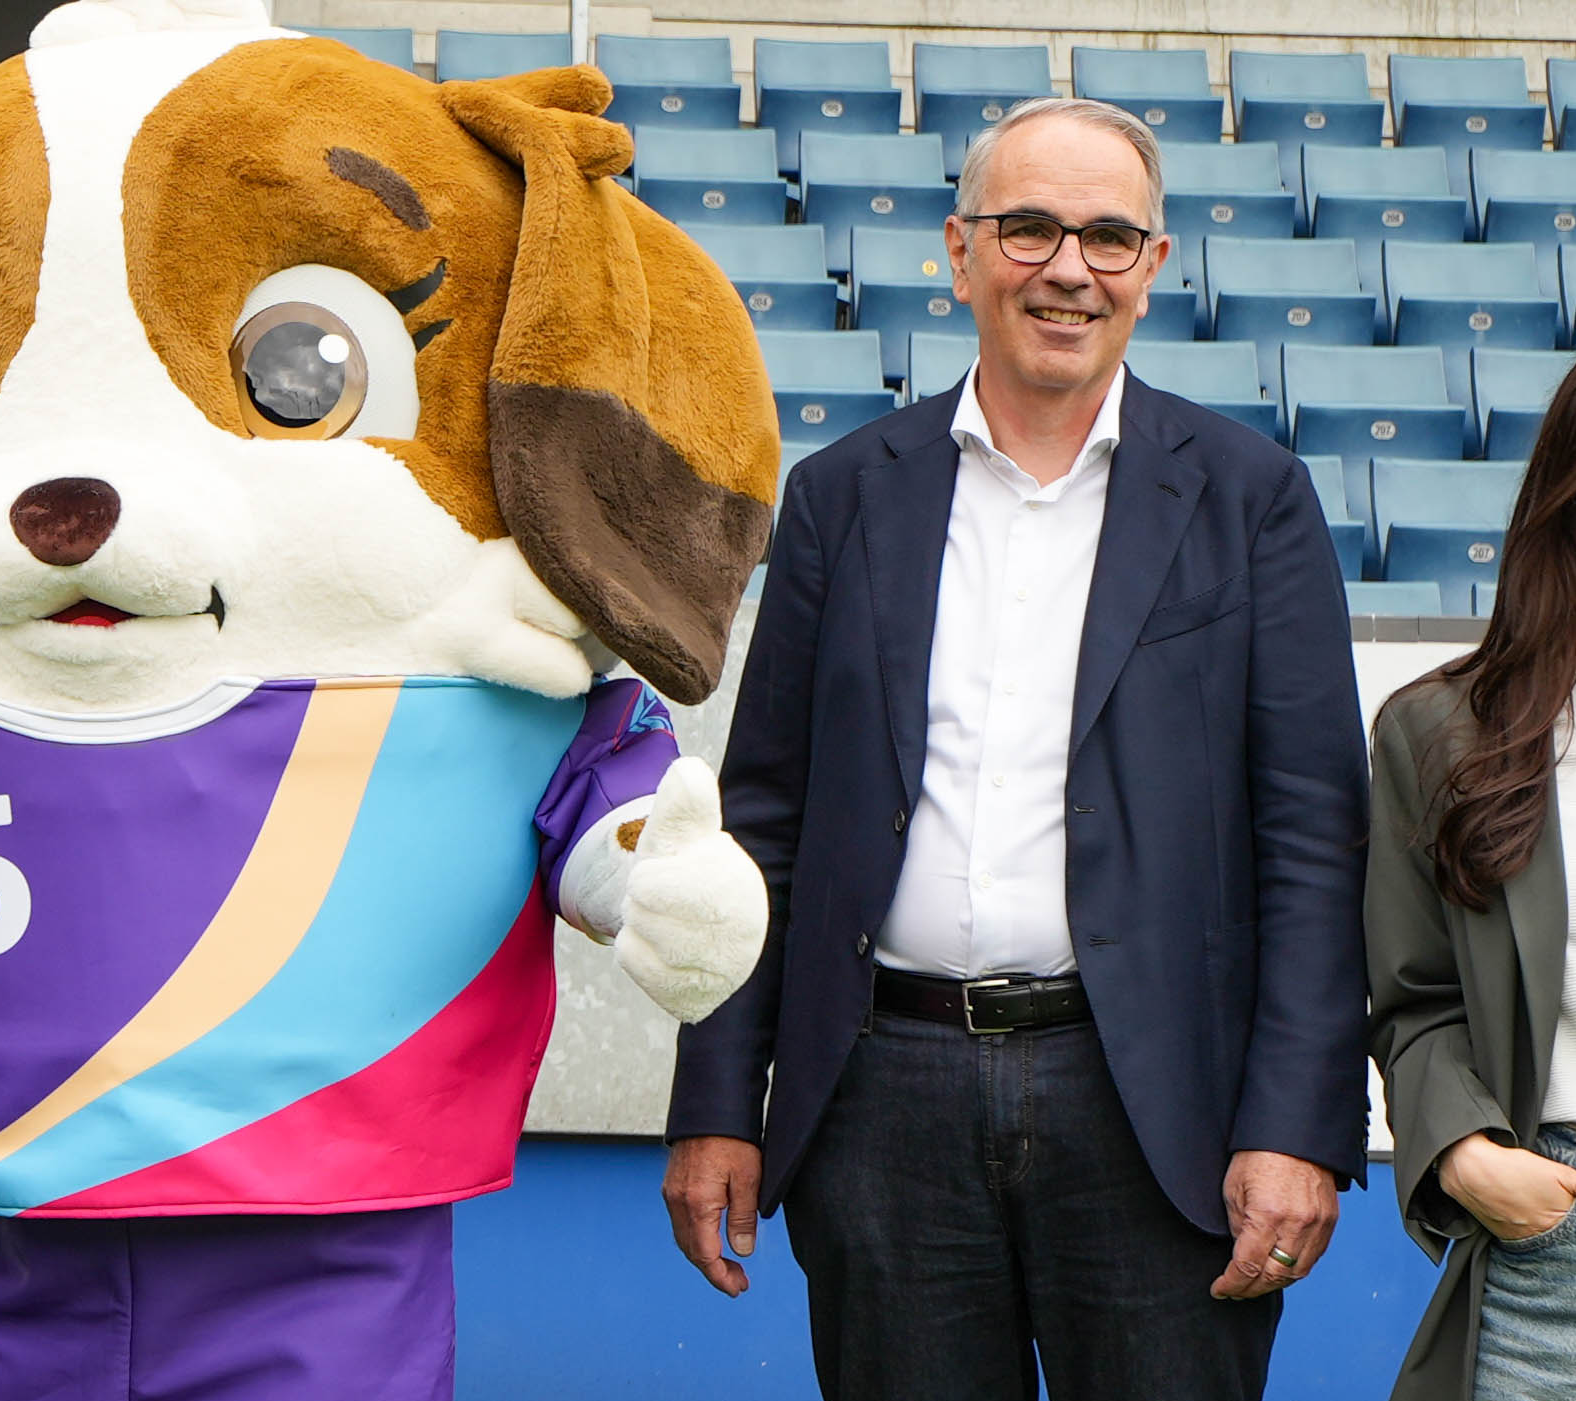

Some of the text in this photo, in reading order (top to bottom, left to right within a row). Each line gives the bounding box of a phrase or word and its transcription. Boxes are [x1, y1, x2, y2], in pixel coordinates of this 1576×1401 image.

[1291, 311, 1307, 322] 207
[805, 408, 821, 420] 204
[1375, 424, 1392, 436] 207
[1473, 546, 1490, 559] 207
